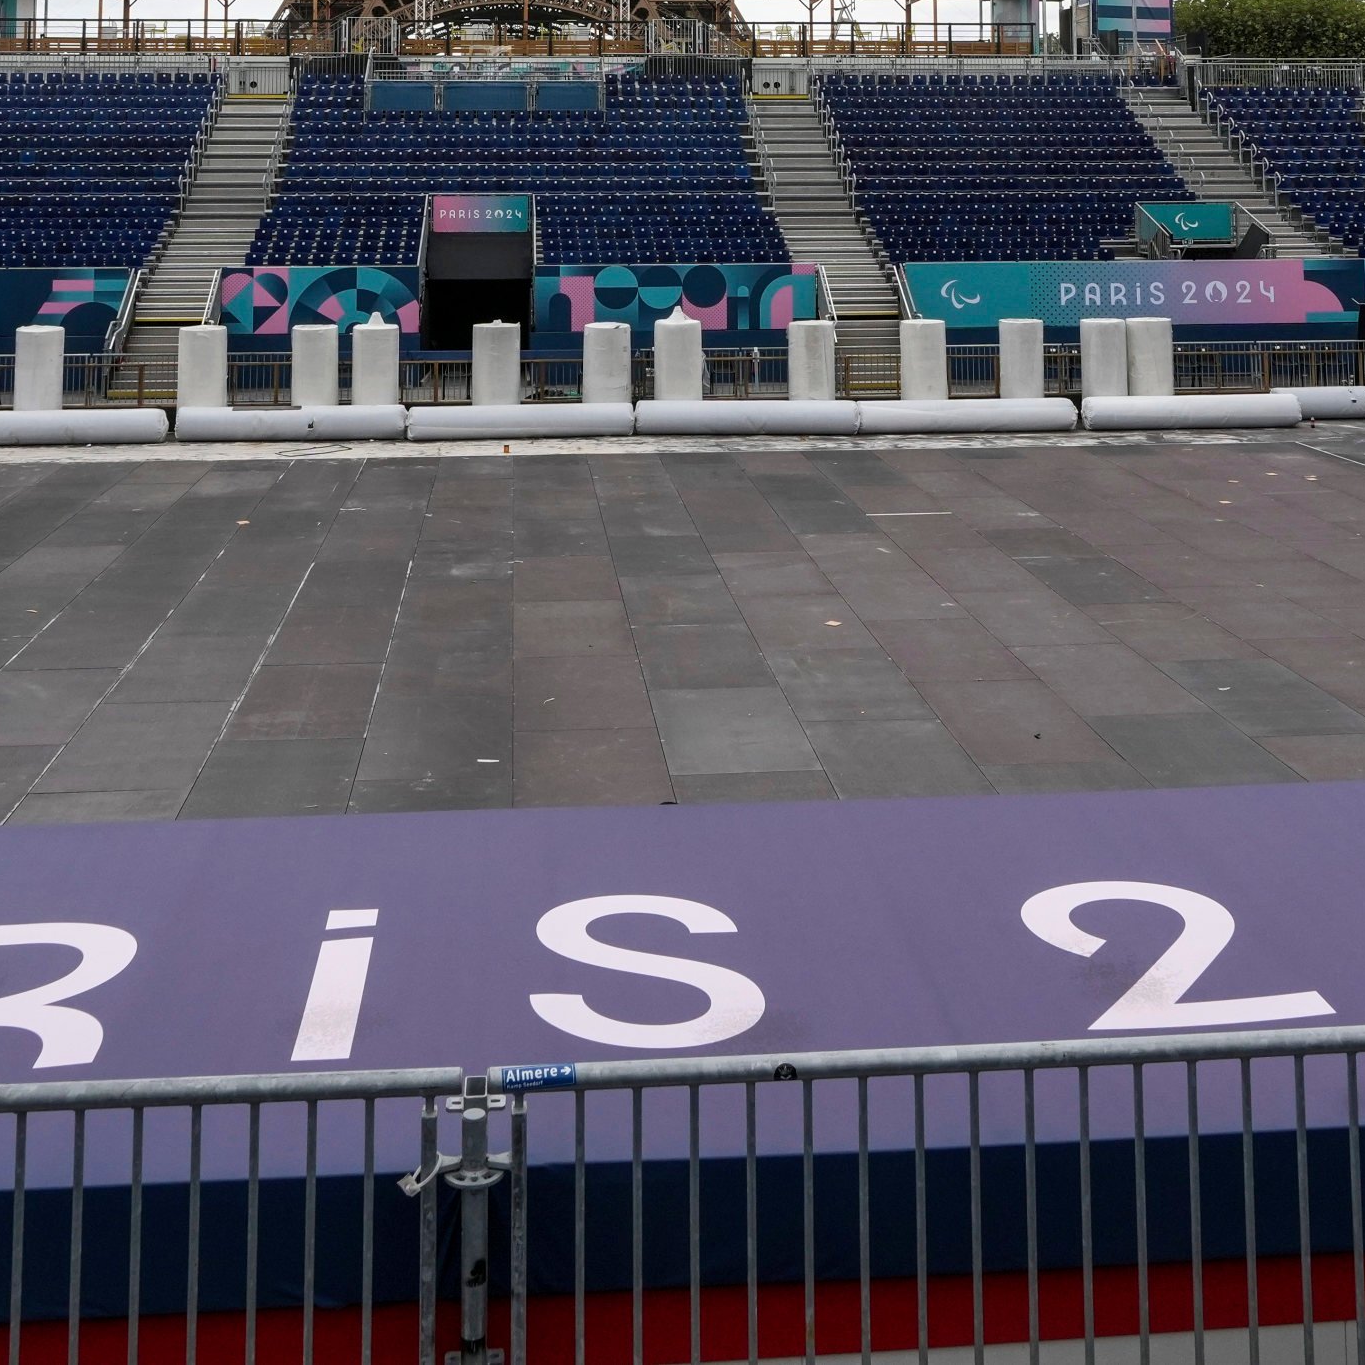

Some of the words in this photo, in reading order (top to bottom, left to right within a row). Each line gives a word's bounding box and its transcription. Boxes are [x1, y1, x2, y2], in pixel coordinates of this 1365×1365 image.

[485, 209, 522, 219] 2024
[1181, 280, 1275, 304] 2024
[506, 1066, 558, 1083] Almere
